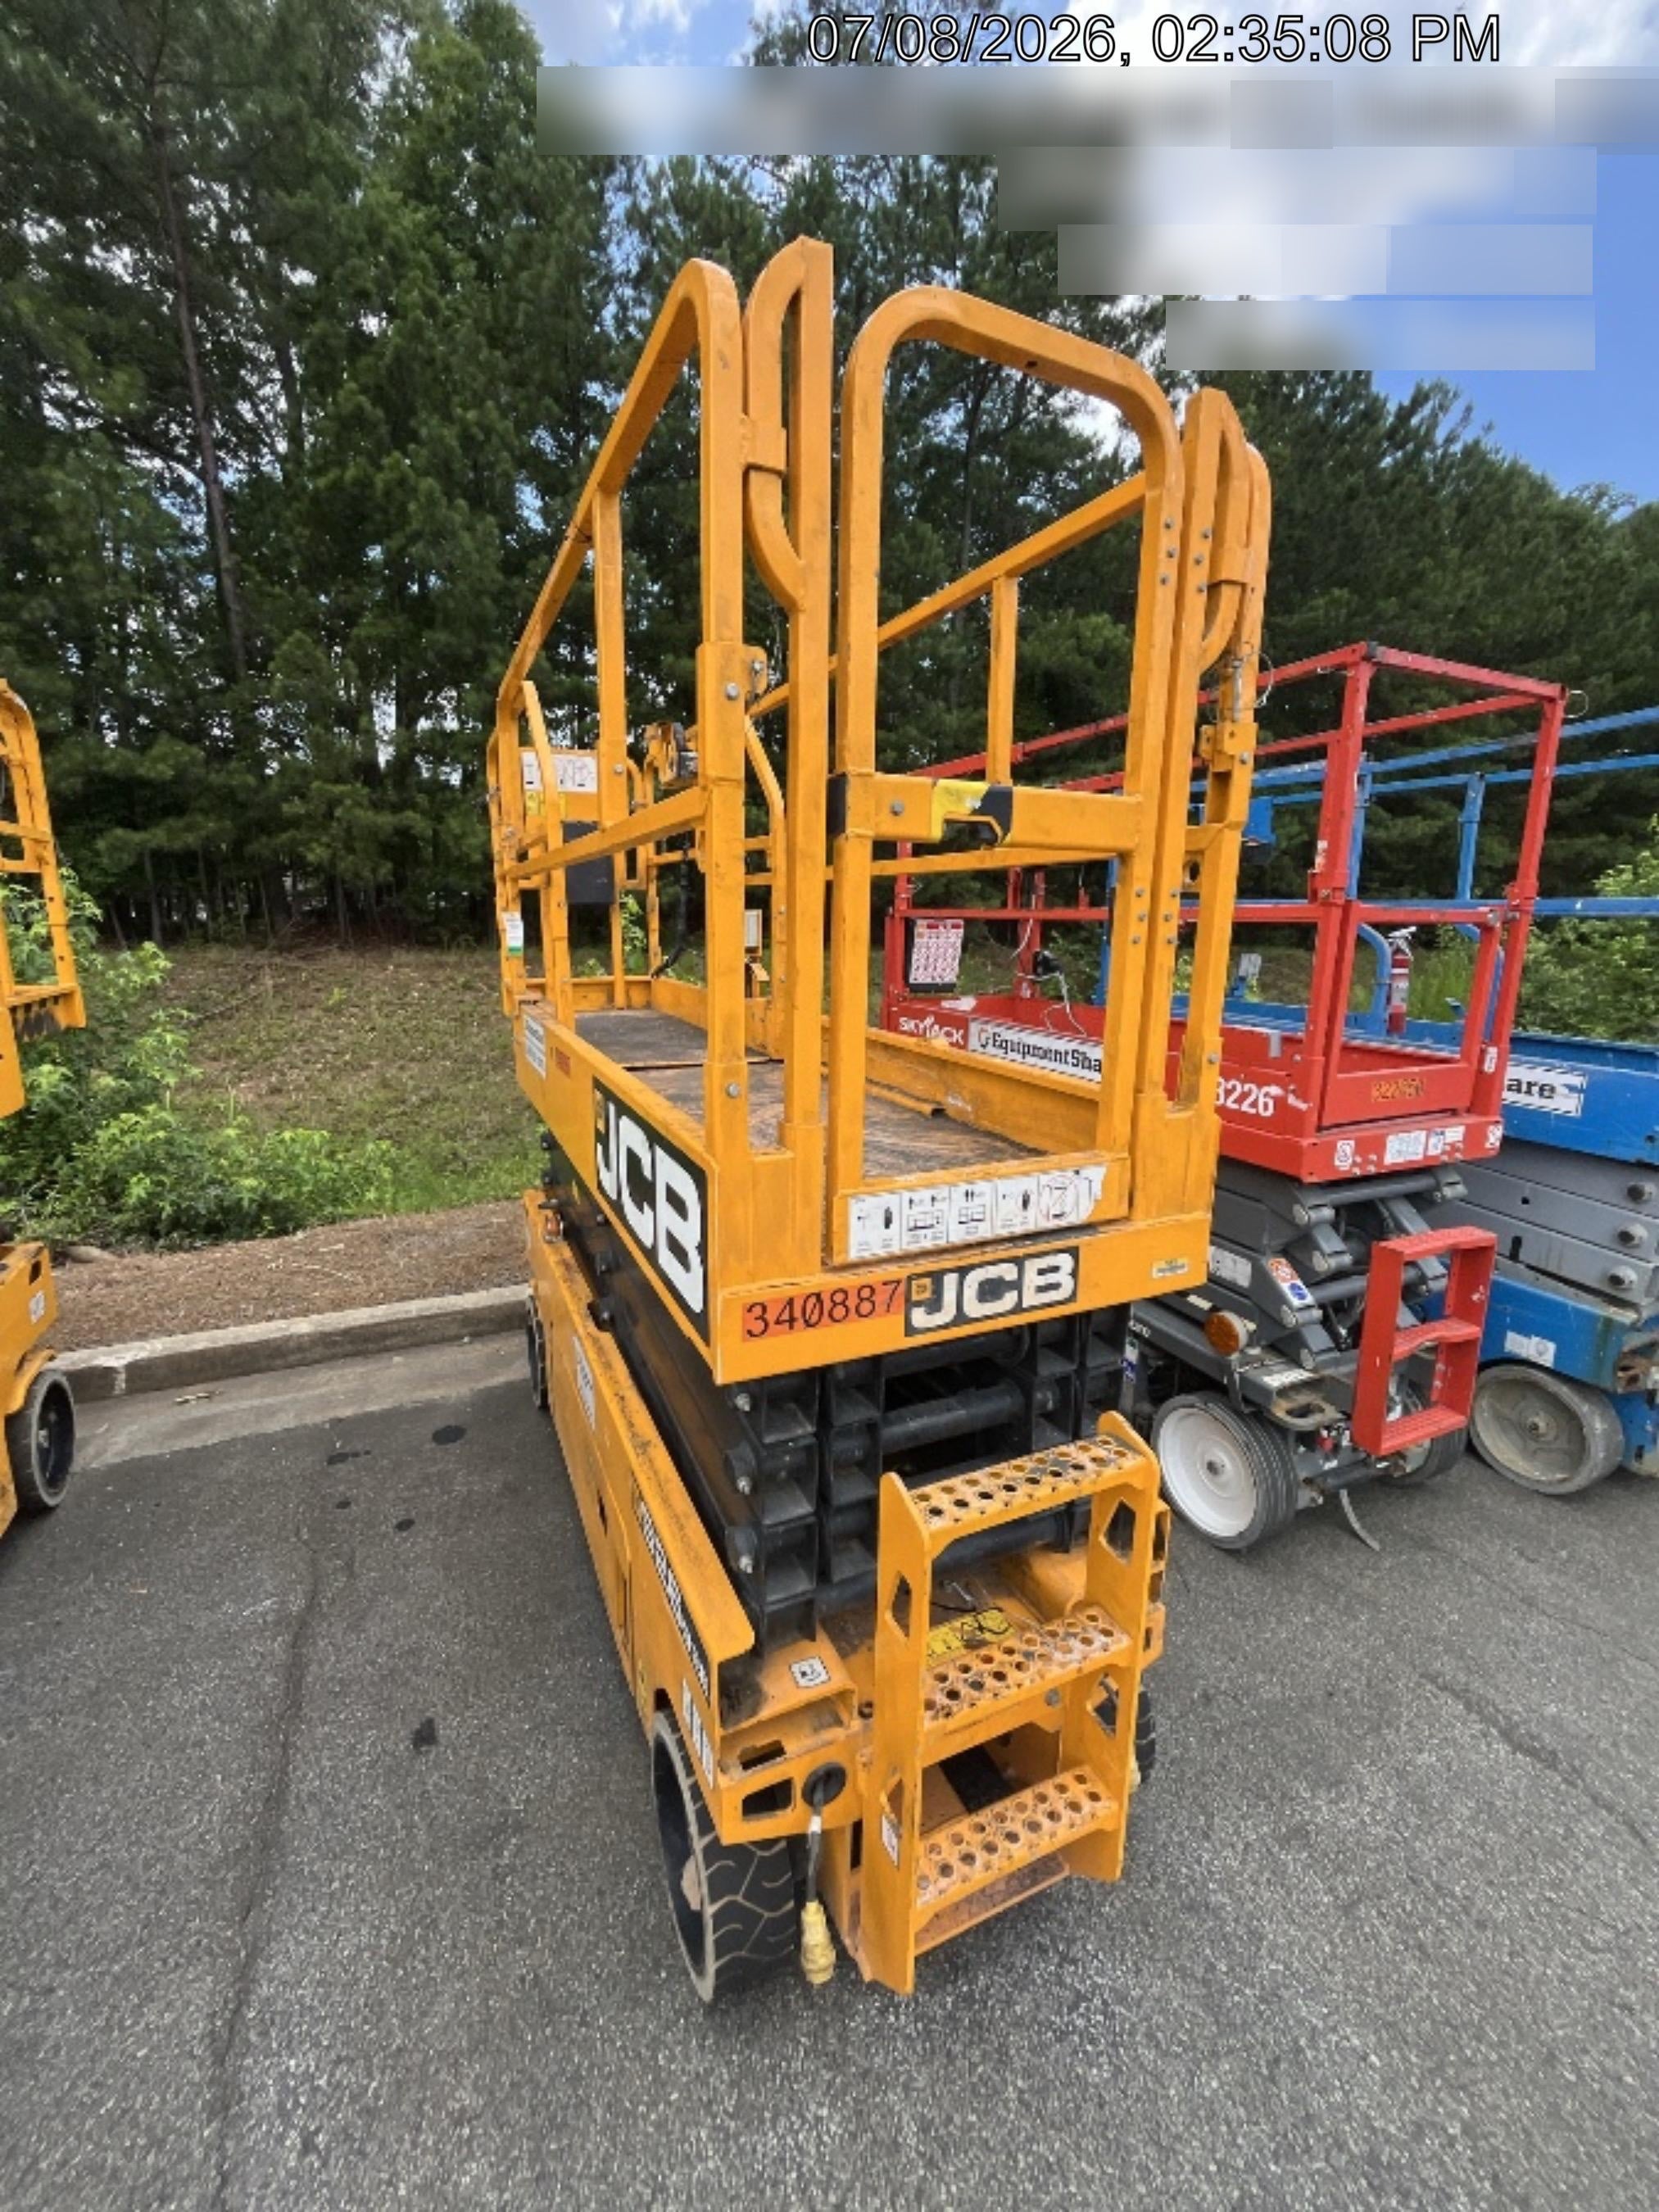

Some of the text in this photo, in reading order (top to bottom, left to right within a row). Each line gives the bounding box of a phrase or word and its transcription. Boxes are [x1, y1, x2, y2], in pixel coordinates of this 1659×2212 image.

[899, 1015, 964, 1045] SKYJACK
[991, 1031, 1102, 1073] EquipmentSha
[1507, 1078, 1556, 1099] are
[596, 1100, 705, 1313] JCB
[746, 1279, 903, 1339] 340887
[910, 1253, 1077, 1329] JCB
